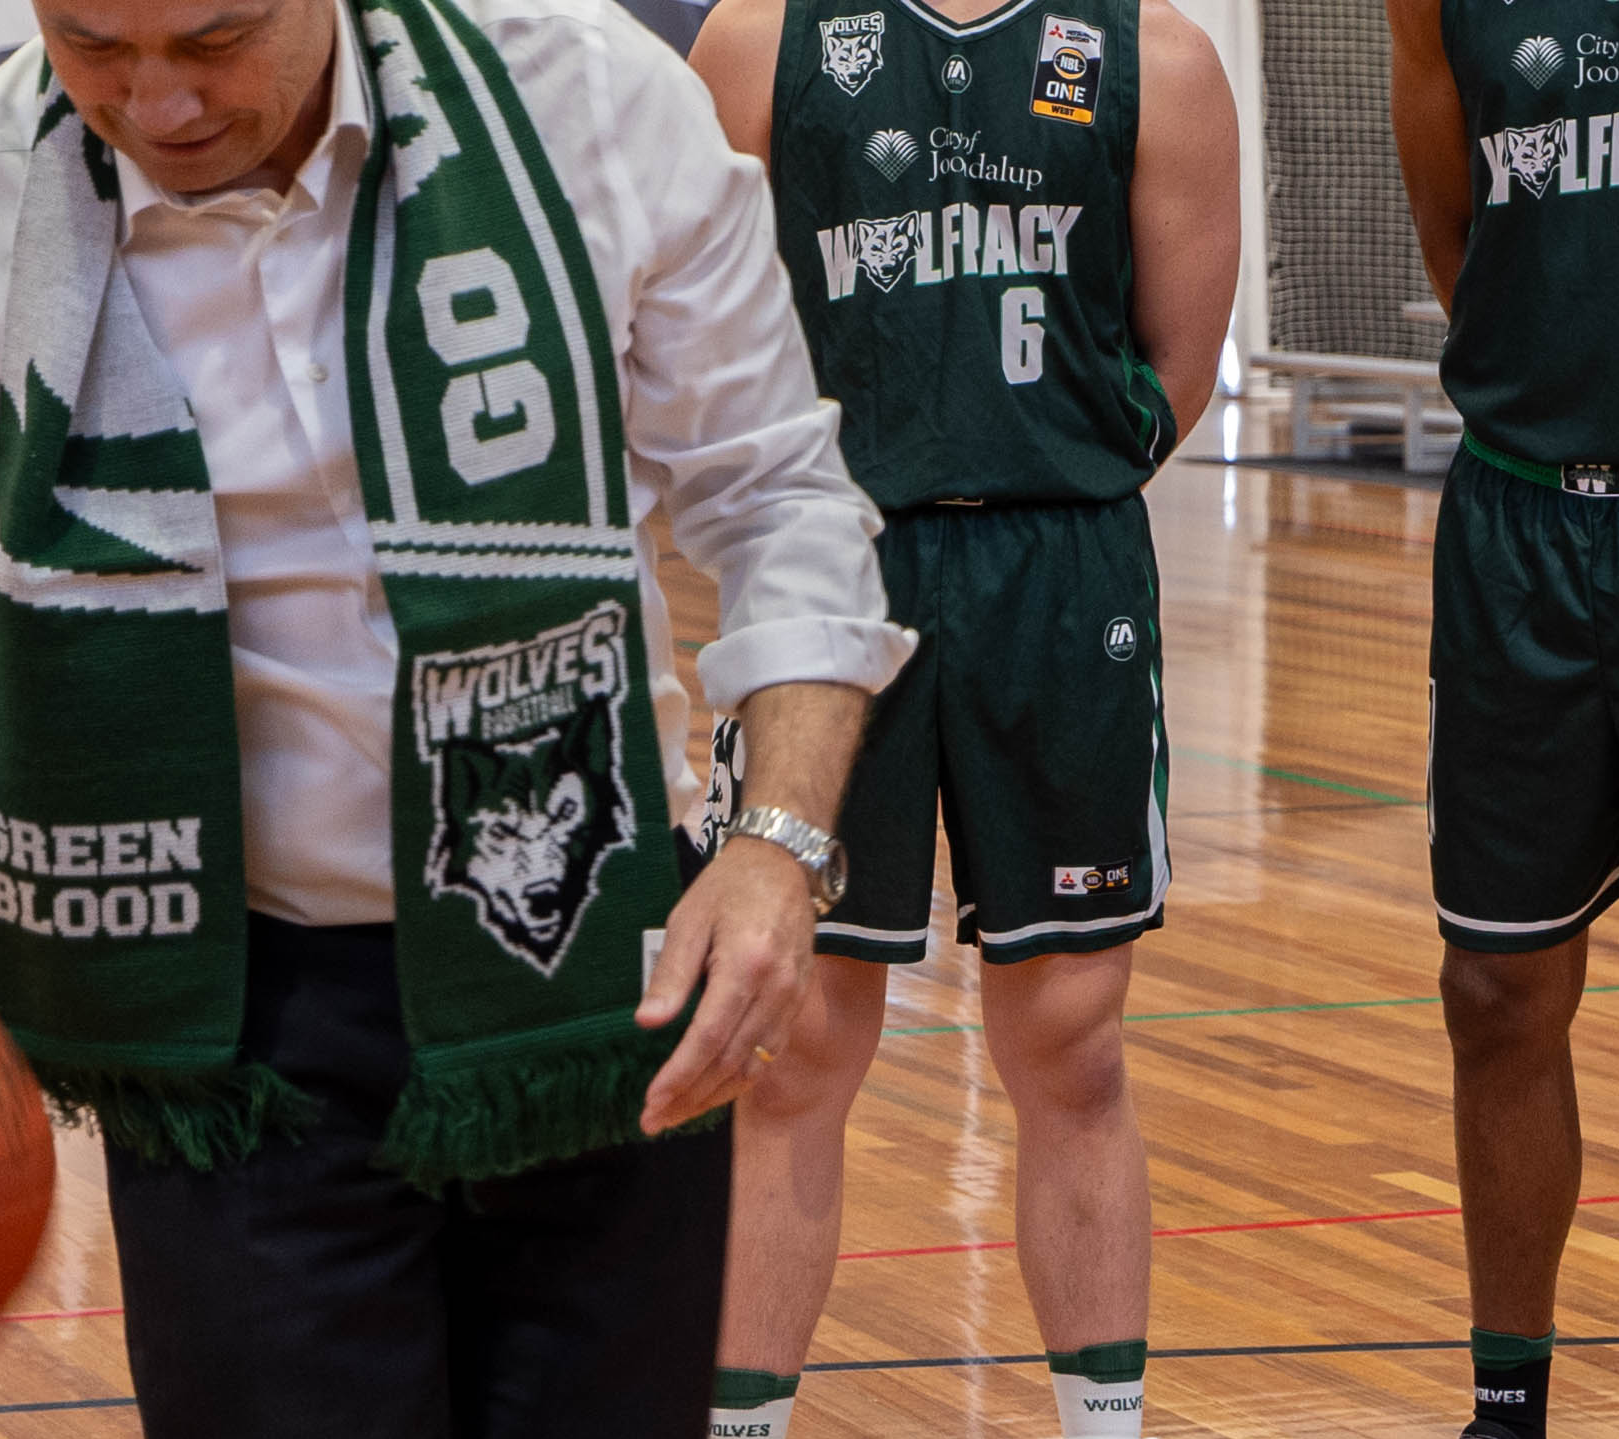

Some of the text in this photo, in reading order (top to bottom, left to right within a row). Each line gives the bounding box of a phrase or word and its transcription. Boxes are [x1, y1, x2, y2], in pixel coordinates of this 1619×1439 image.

[824, 15, 882, 36] WOLVES
[1576, 33, 1619, 59] City
[1060, 55, 1080, 72] NBL
[1045, 80, 1086, 103] ONE
[1001, 286, 1046, 385] 6
[426, 611, 618, 741] WOLVES
[1475, 1387, 1526, 1403] OLVES
[709, 1423, 771, 1438] OLVES
